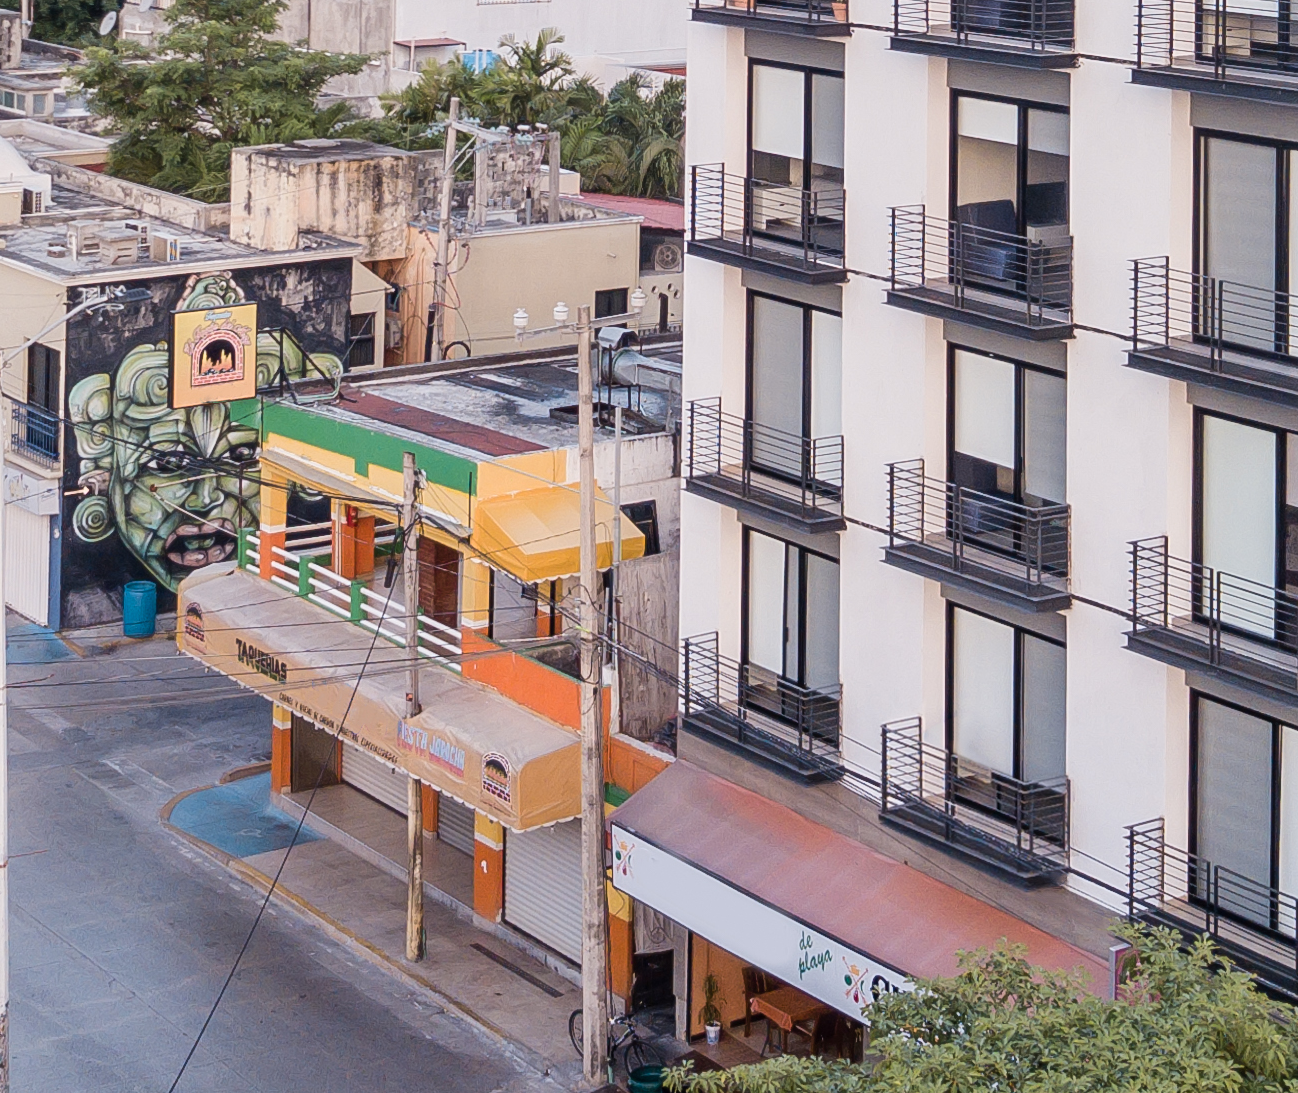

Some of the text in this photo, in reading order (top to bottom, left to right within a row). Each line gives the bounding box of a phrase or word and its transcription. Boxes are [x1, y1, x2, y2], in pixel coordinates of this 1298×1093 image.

[236, 638, 287, 681] TAQUERIAS
[799, 930, 814, 951] de
[798, 949, 834, 981] playa
